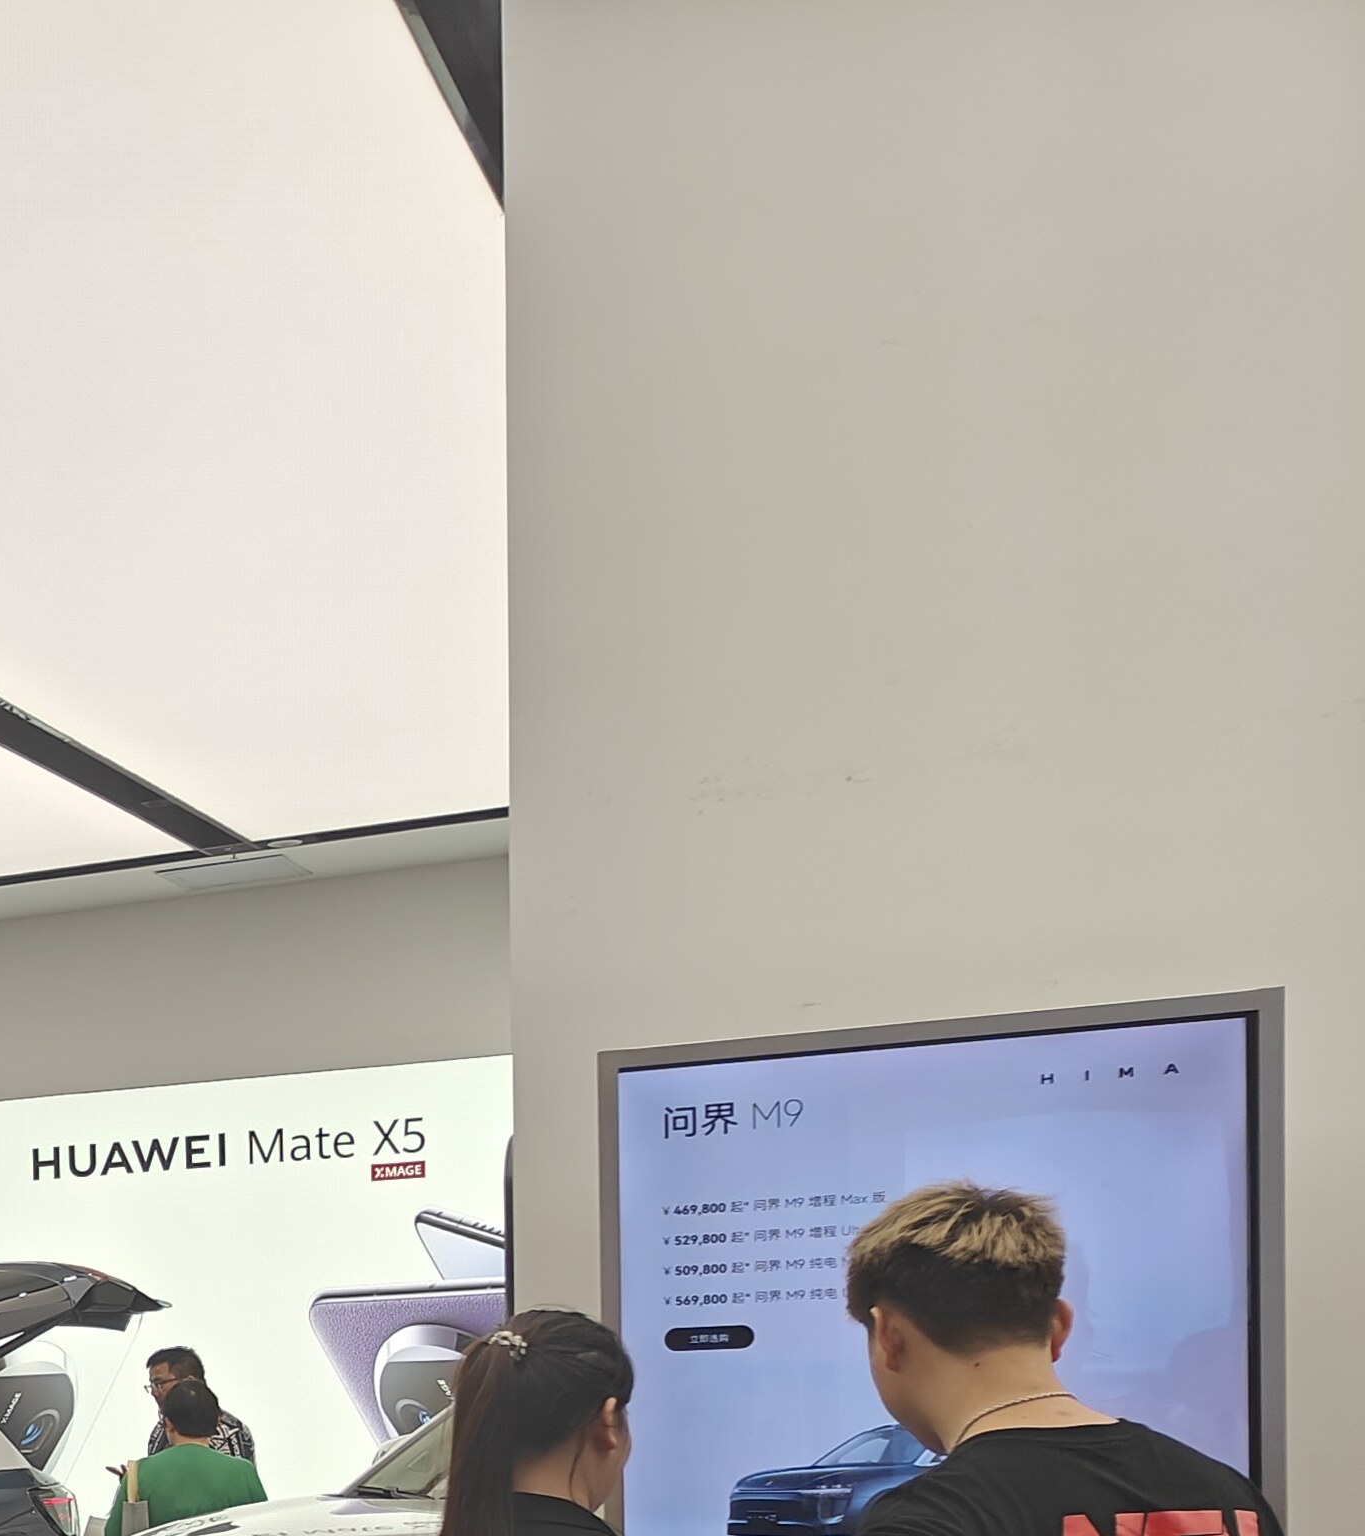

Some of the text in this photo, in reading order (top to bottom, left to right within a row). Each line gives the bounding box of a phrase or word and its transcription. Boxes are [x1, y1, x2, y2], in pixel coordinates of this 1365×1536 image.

[1040, 1063, 1179, 1084] HIMA
[664, 1098, 803, 1138] 问界 M9
[32, 1117, 426, 1181] HUAWEI Mate X5
[373, 1163, 424, 1180] XMAGE
[673, 1203, 726, 1215] 469,800
[674, 1233, 727, 1246] 529,800
[674, 1263, 727, 1276] 509,800
[675, 1294, 728, 1306] 569,800
